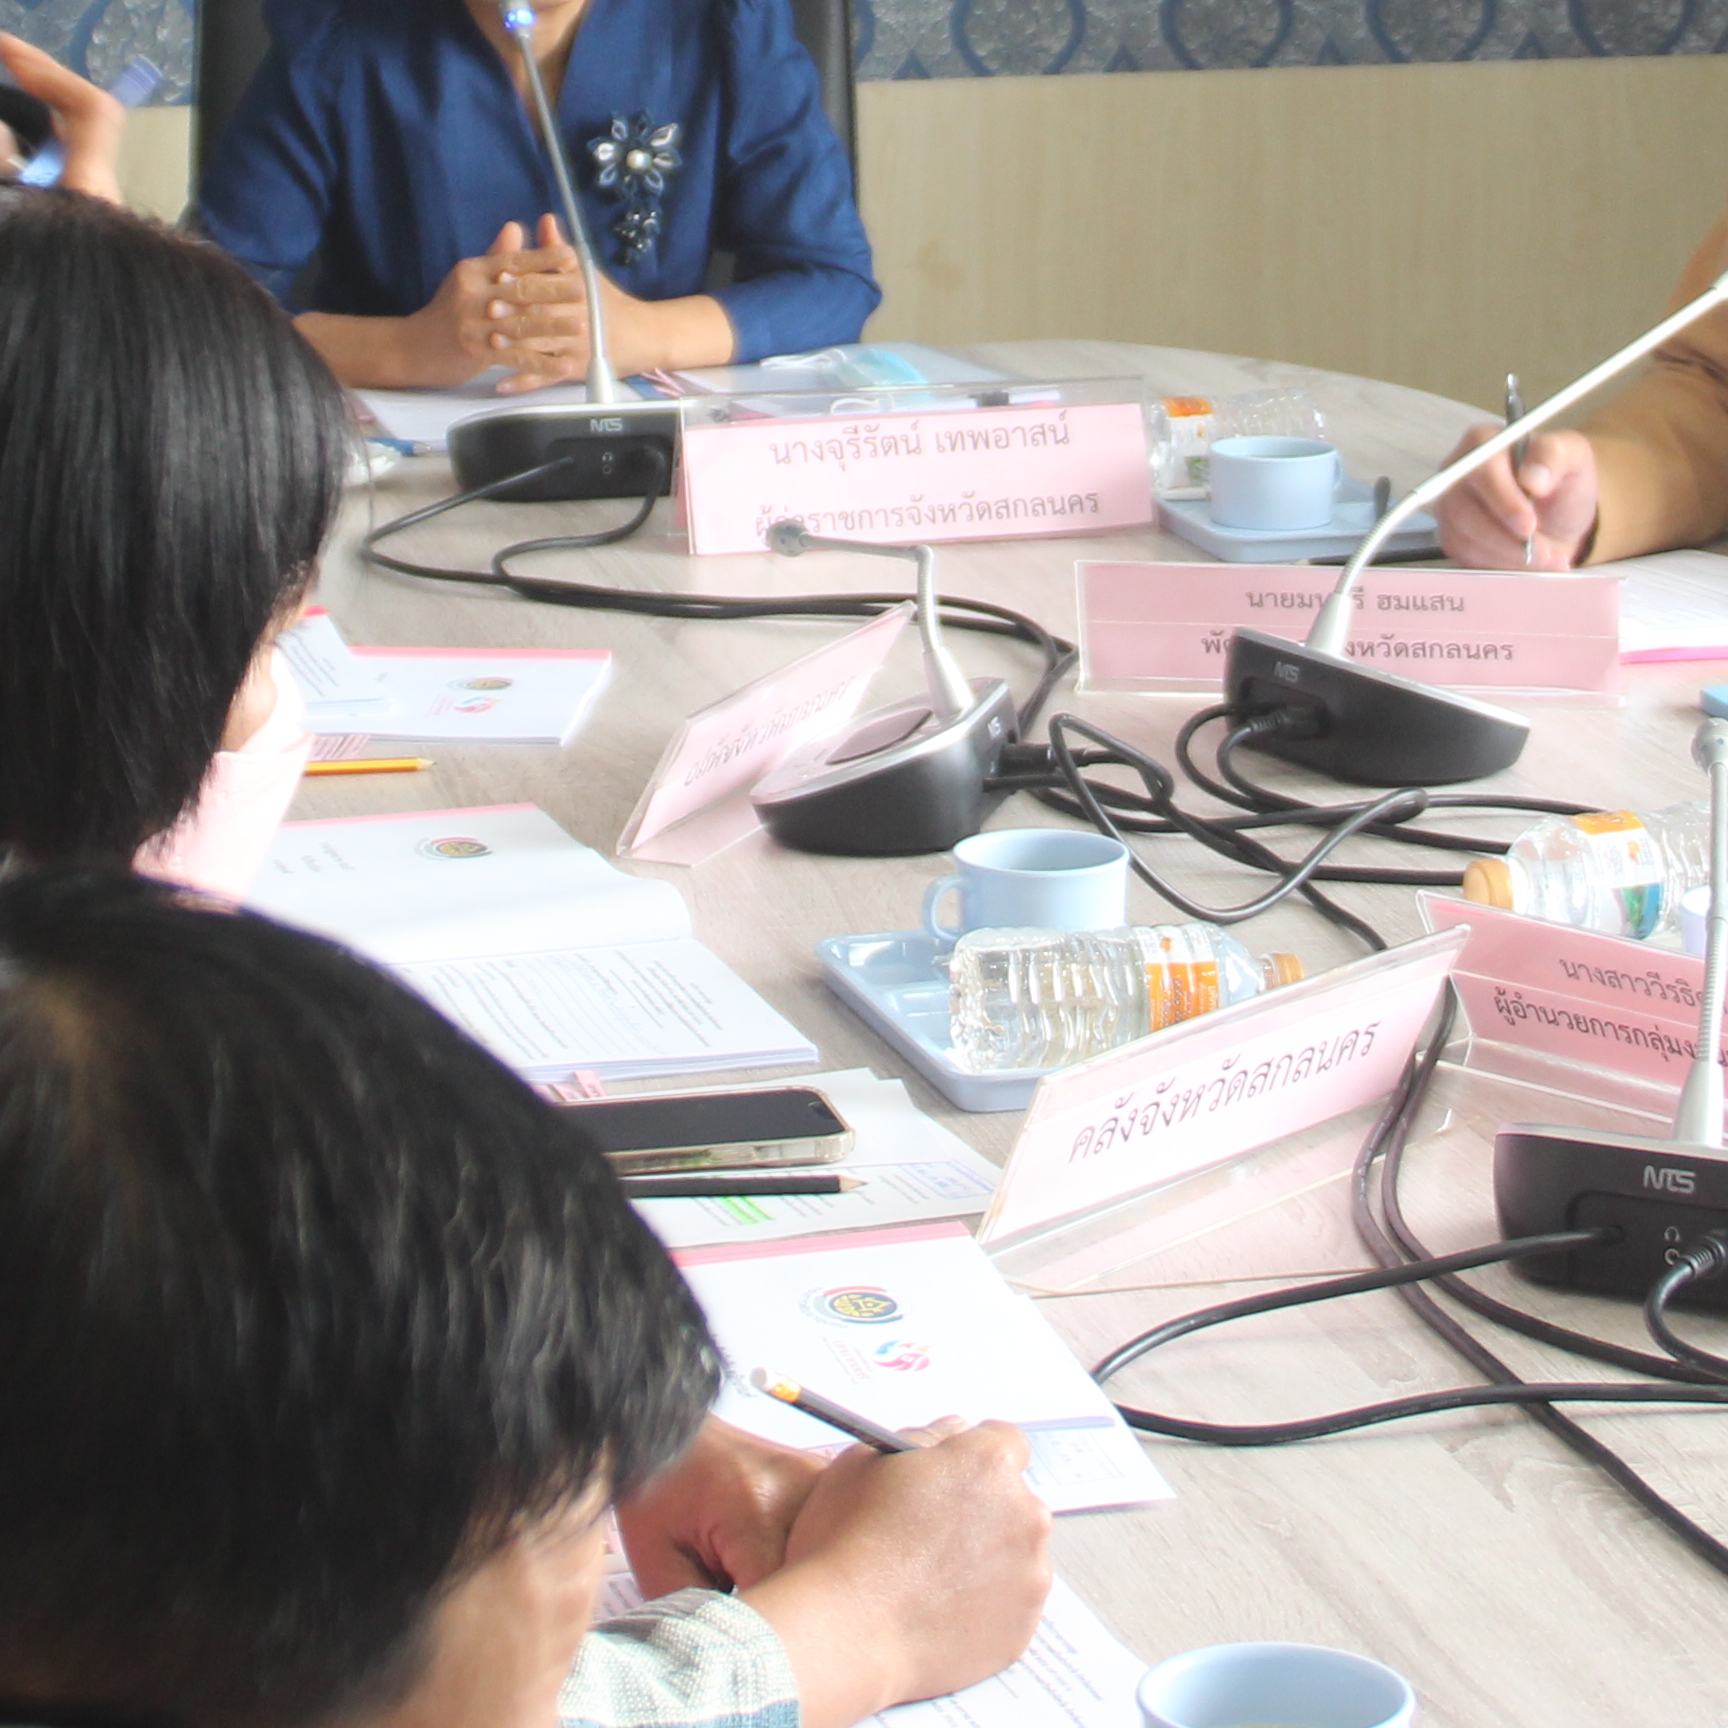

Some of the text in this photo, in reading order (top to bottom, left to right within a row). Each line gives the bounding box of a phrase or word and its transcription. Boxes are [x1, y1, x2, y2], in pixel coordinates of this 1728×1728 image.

[768, 409, 1070, 473] นางจุรีรัตน์ เทพอาสน์
[755, 489, 1100, 546] ผู้่ราชการจังหวัดสกลนคร
[1245, 585, 1465, 613] นายมรี ฮมแสน
[1559, 958, 1728, 1015] นางสาววีรธิ
[1068, 1021, 1381, 1163] คลังจังหวัดสกลนคร
